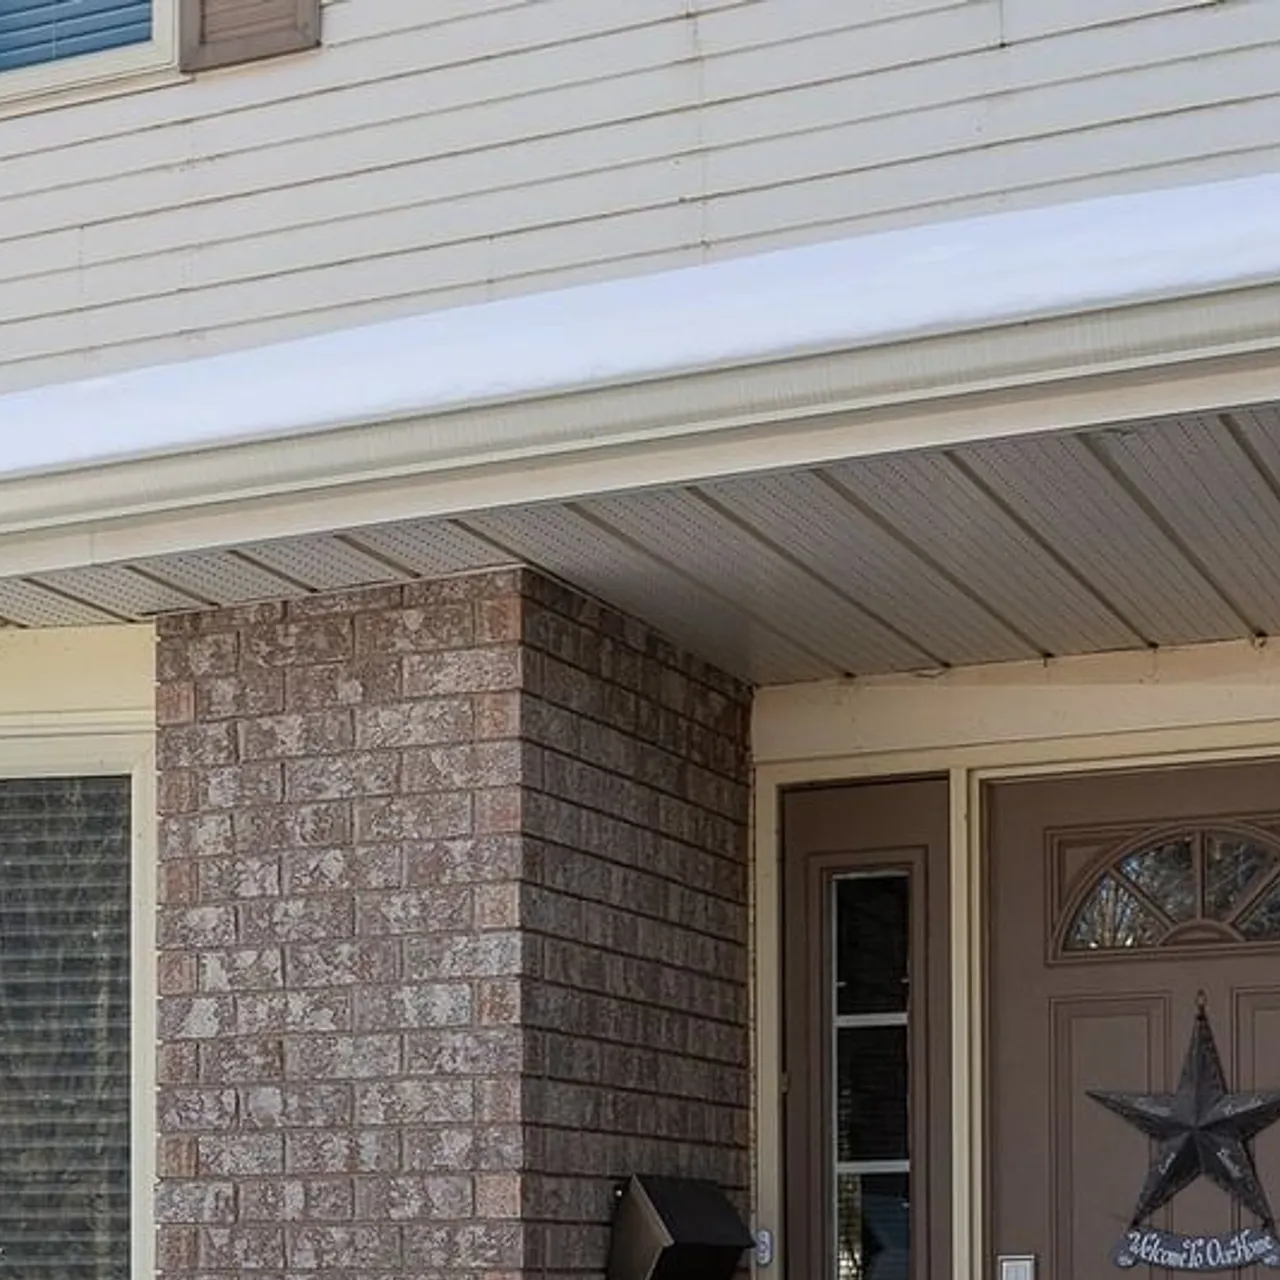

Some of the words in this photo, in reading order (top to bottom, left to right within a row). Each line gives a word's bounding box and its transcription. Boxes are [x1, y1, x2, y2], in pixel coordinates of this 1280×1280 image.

[1128, 1231, 1187, 1267] Welcome
[1183, 1238, 1204, 1268] To
[1206, 1238, 1234, 1267] Our
[1231, 1229, 1272, 1262] Home
